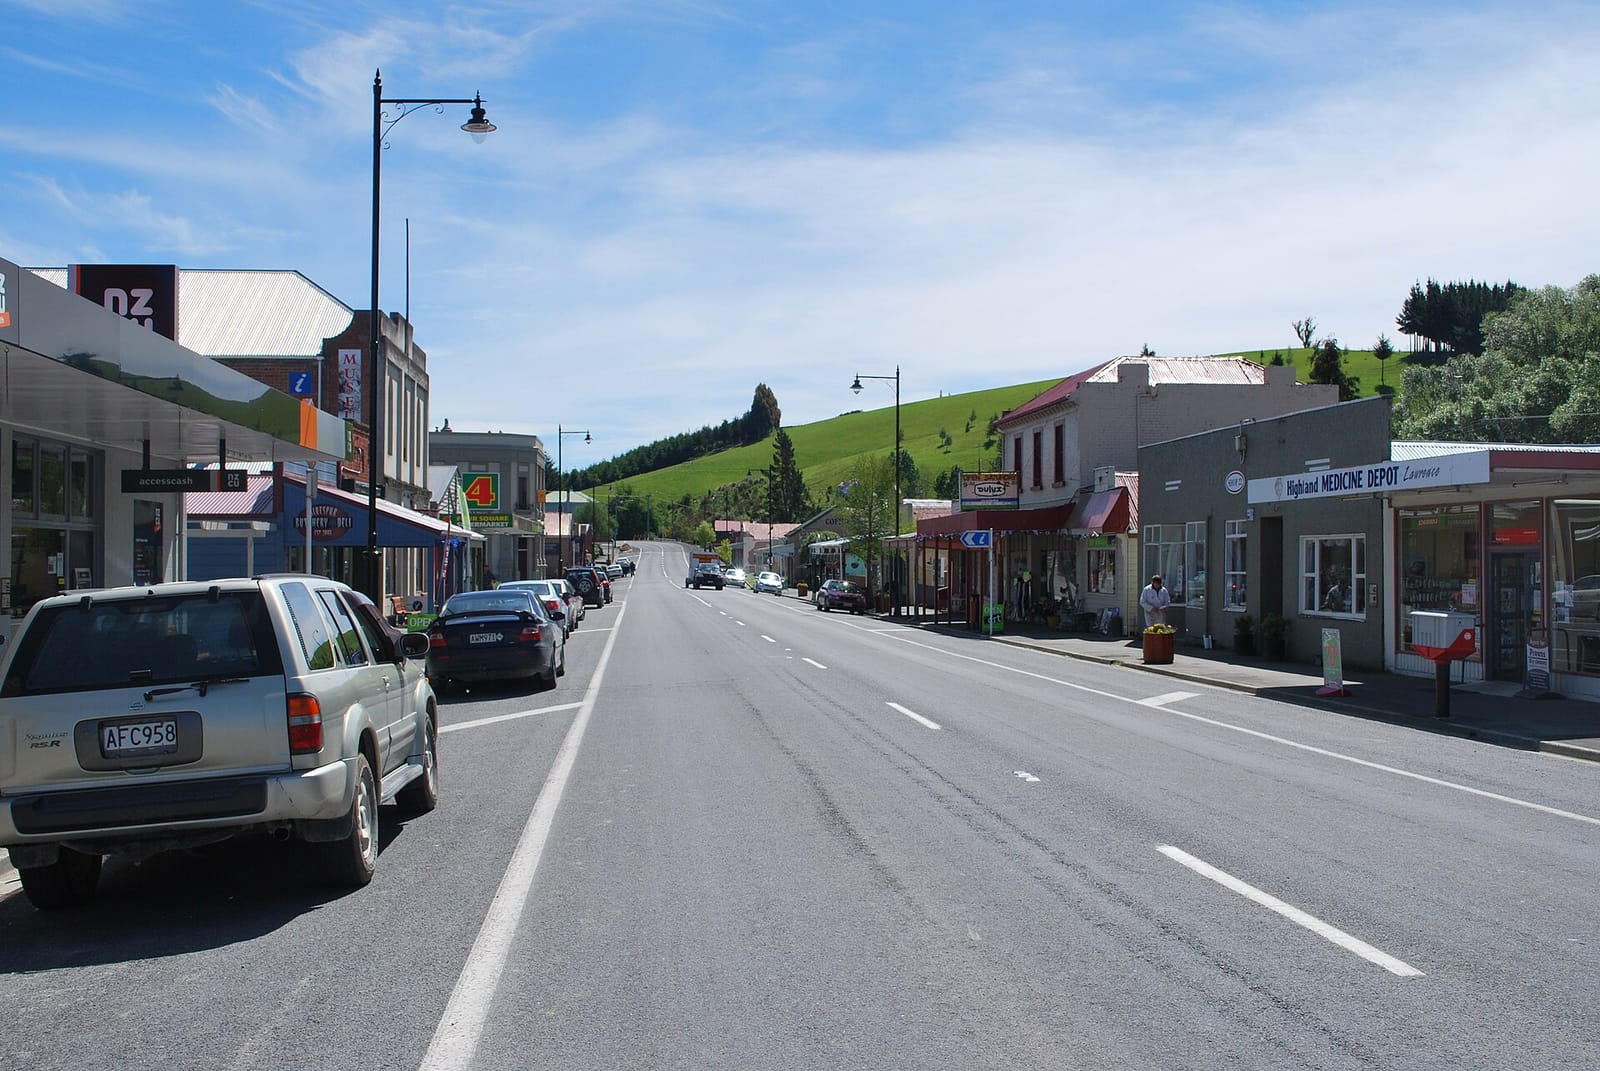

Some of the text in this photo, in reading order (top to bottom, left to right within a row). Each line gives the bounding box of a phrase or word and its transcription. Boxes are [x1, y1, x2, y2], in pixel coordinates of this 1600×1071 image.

[139, 477, 193, 485] accesscash
[465, 476, 496, 506] 4
[1286, 475, 1318, 498] Highland
[1322, 470, 1363, 492] MEDICINE
[1367, 466, 1399, 488] DEPOT
[106, 723, 175, 749] AFC958
